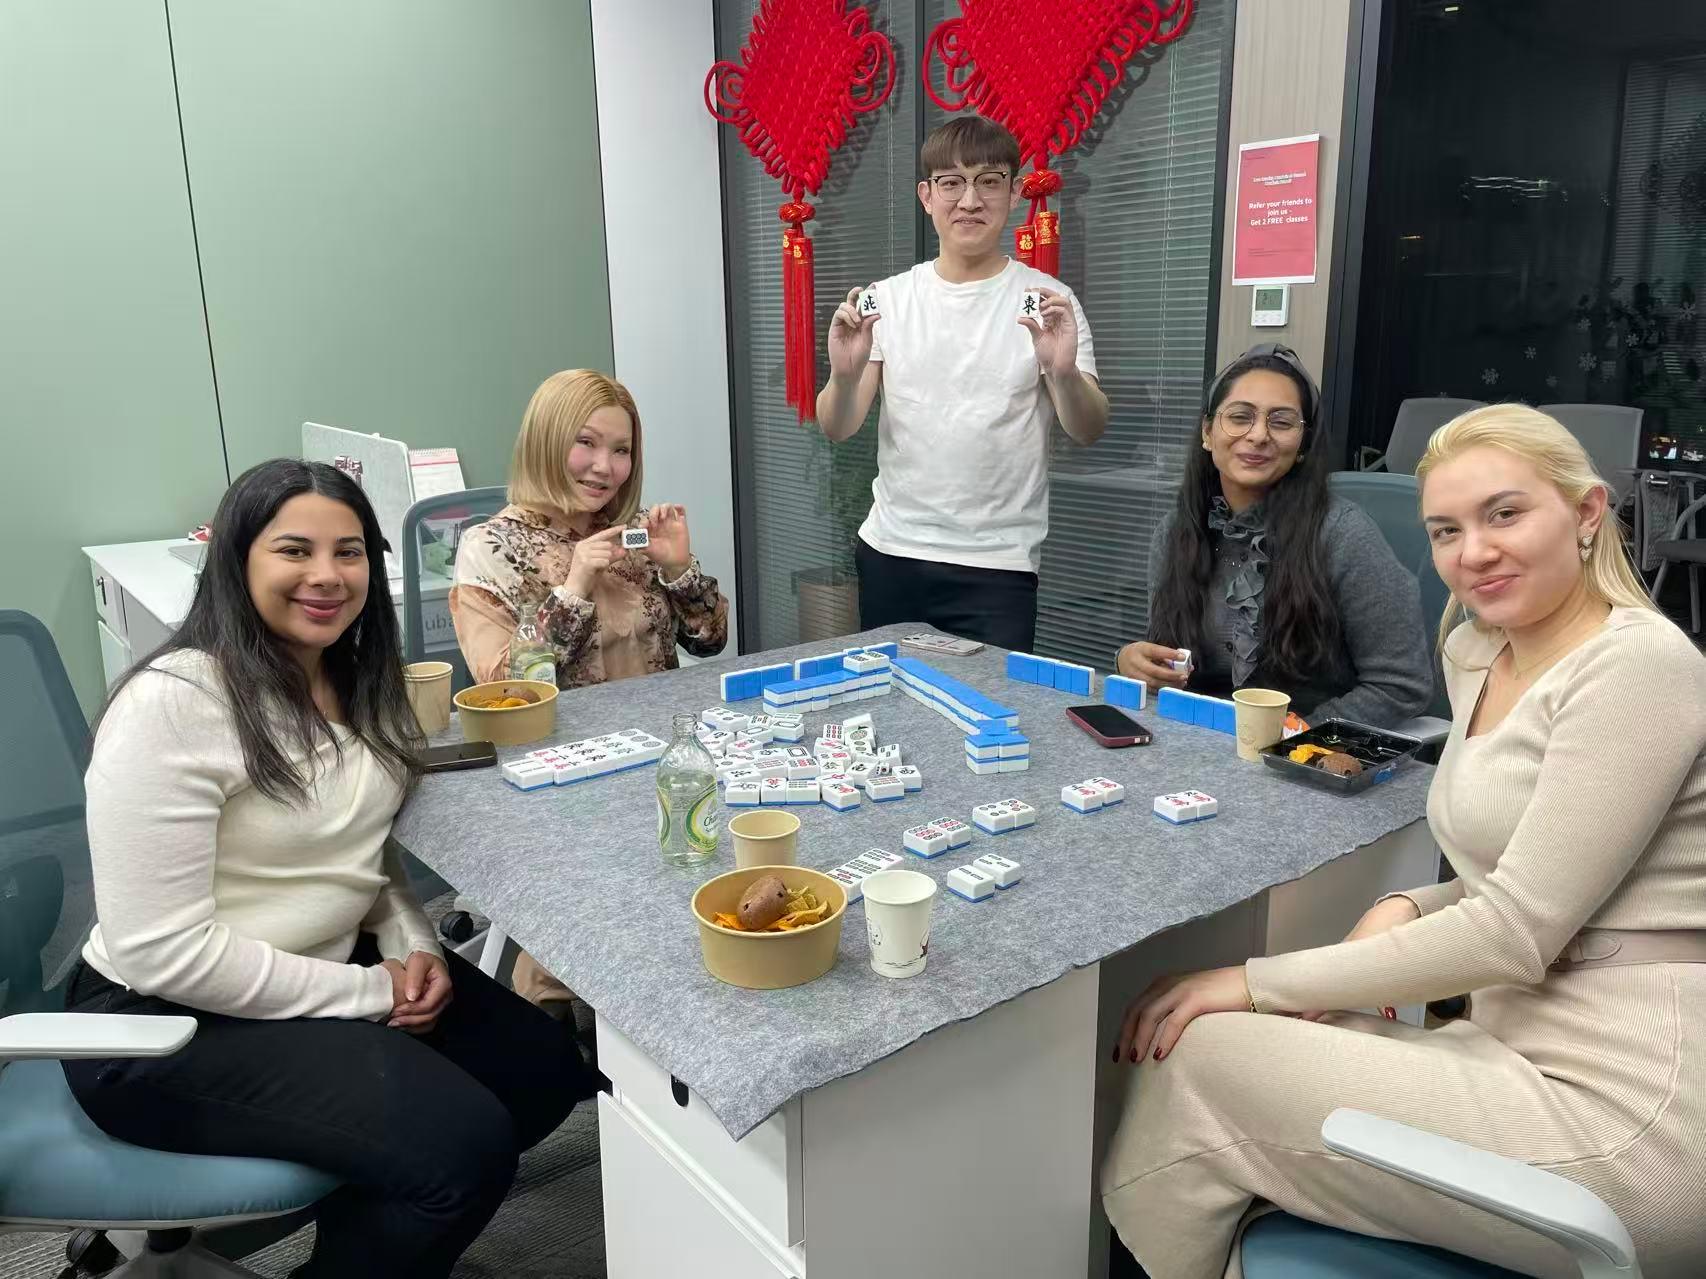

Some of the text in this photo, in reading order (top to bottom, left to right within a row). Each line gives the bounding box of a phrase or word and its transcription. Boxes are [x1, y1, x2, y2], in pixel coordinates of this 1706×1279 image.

[1266, 201, 1280, 209] your
[1281, 198, 1304, 207] friends
[1267, 209, 1279, 217] join
[1267, 217, 1284, 225] FREE
[1286, 215, 1309, 223] classes
[1019, 234, 1033, 250] 福
[863, 294, 877, 311] 北
[1022, 294, 1037, 315] 東
